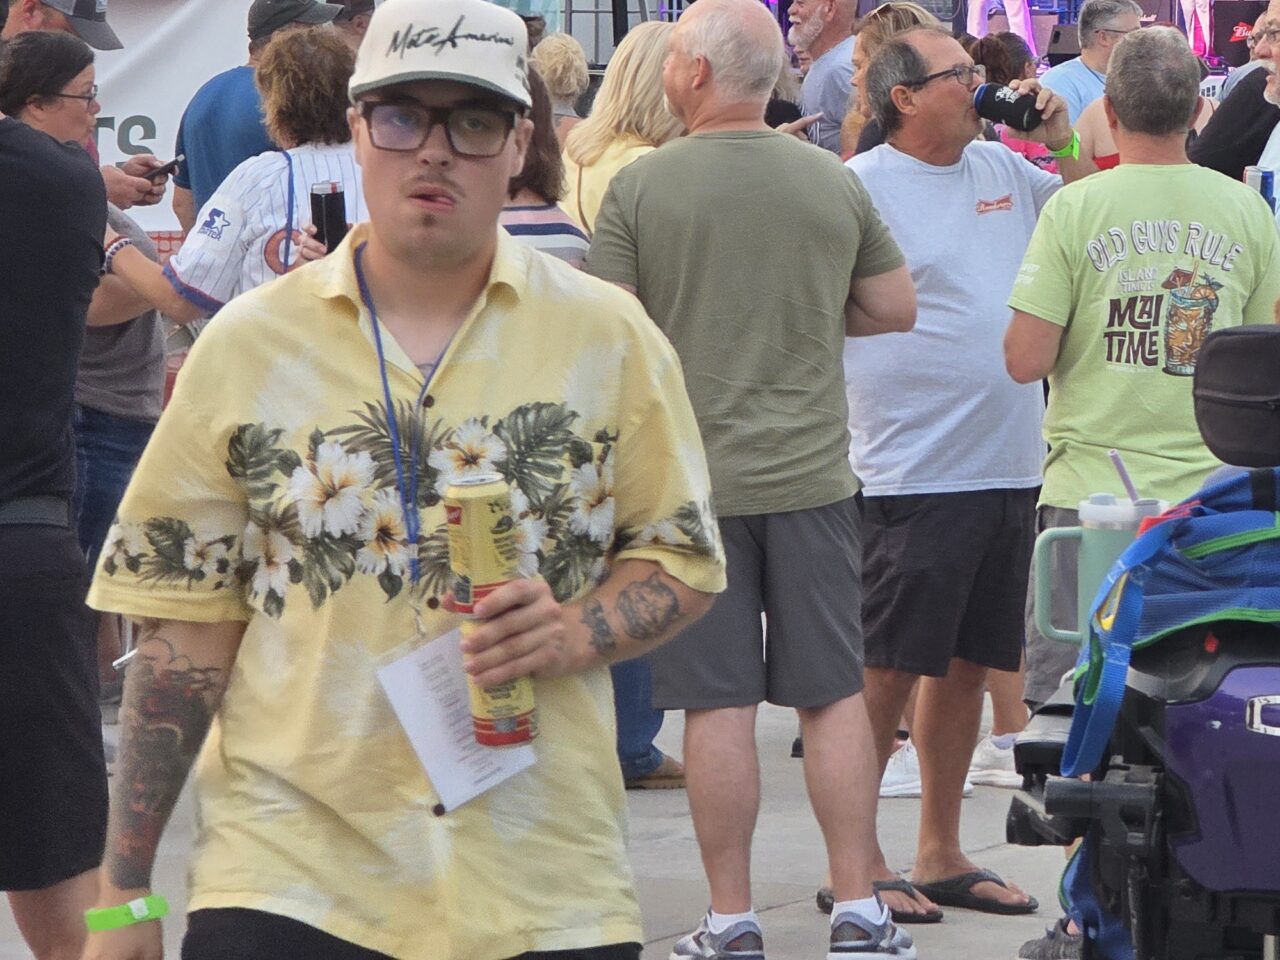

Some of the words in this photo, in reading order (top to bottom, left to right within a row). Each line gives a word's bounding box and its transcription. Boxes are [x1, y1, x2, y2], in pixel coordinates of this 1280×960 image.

[1087, 227, 1128, 271] OLD
[1131, 220, 1181, 254] GUYS
[1184, 221, 1244, 271] RULE
[1107, 294, 1164, 330] MAI
[1104, 330, 1159, 366] TIME
